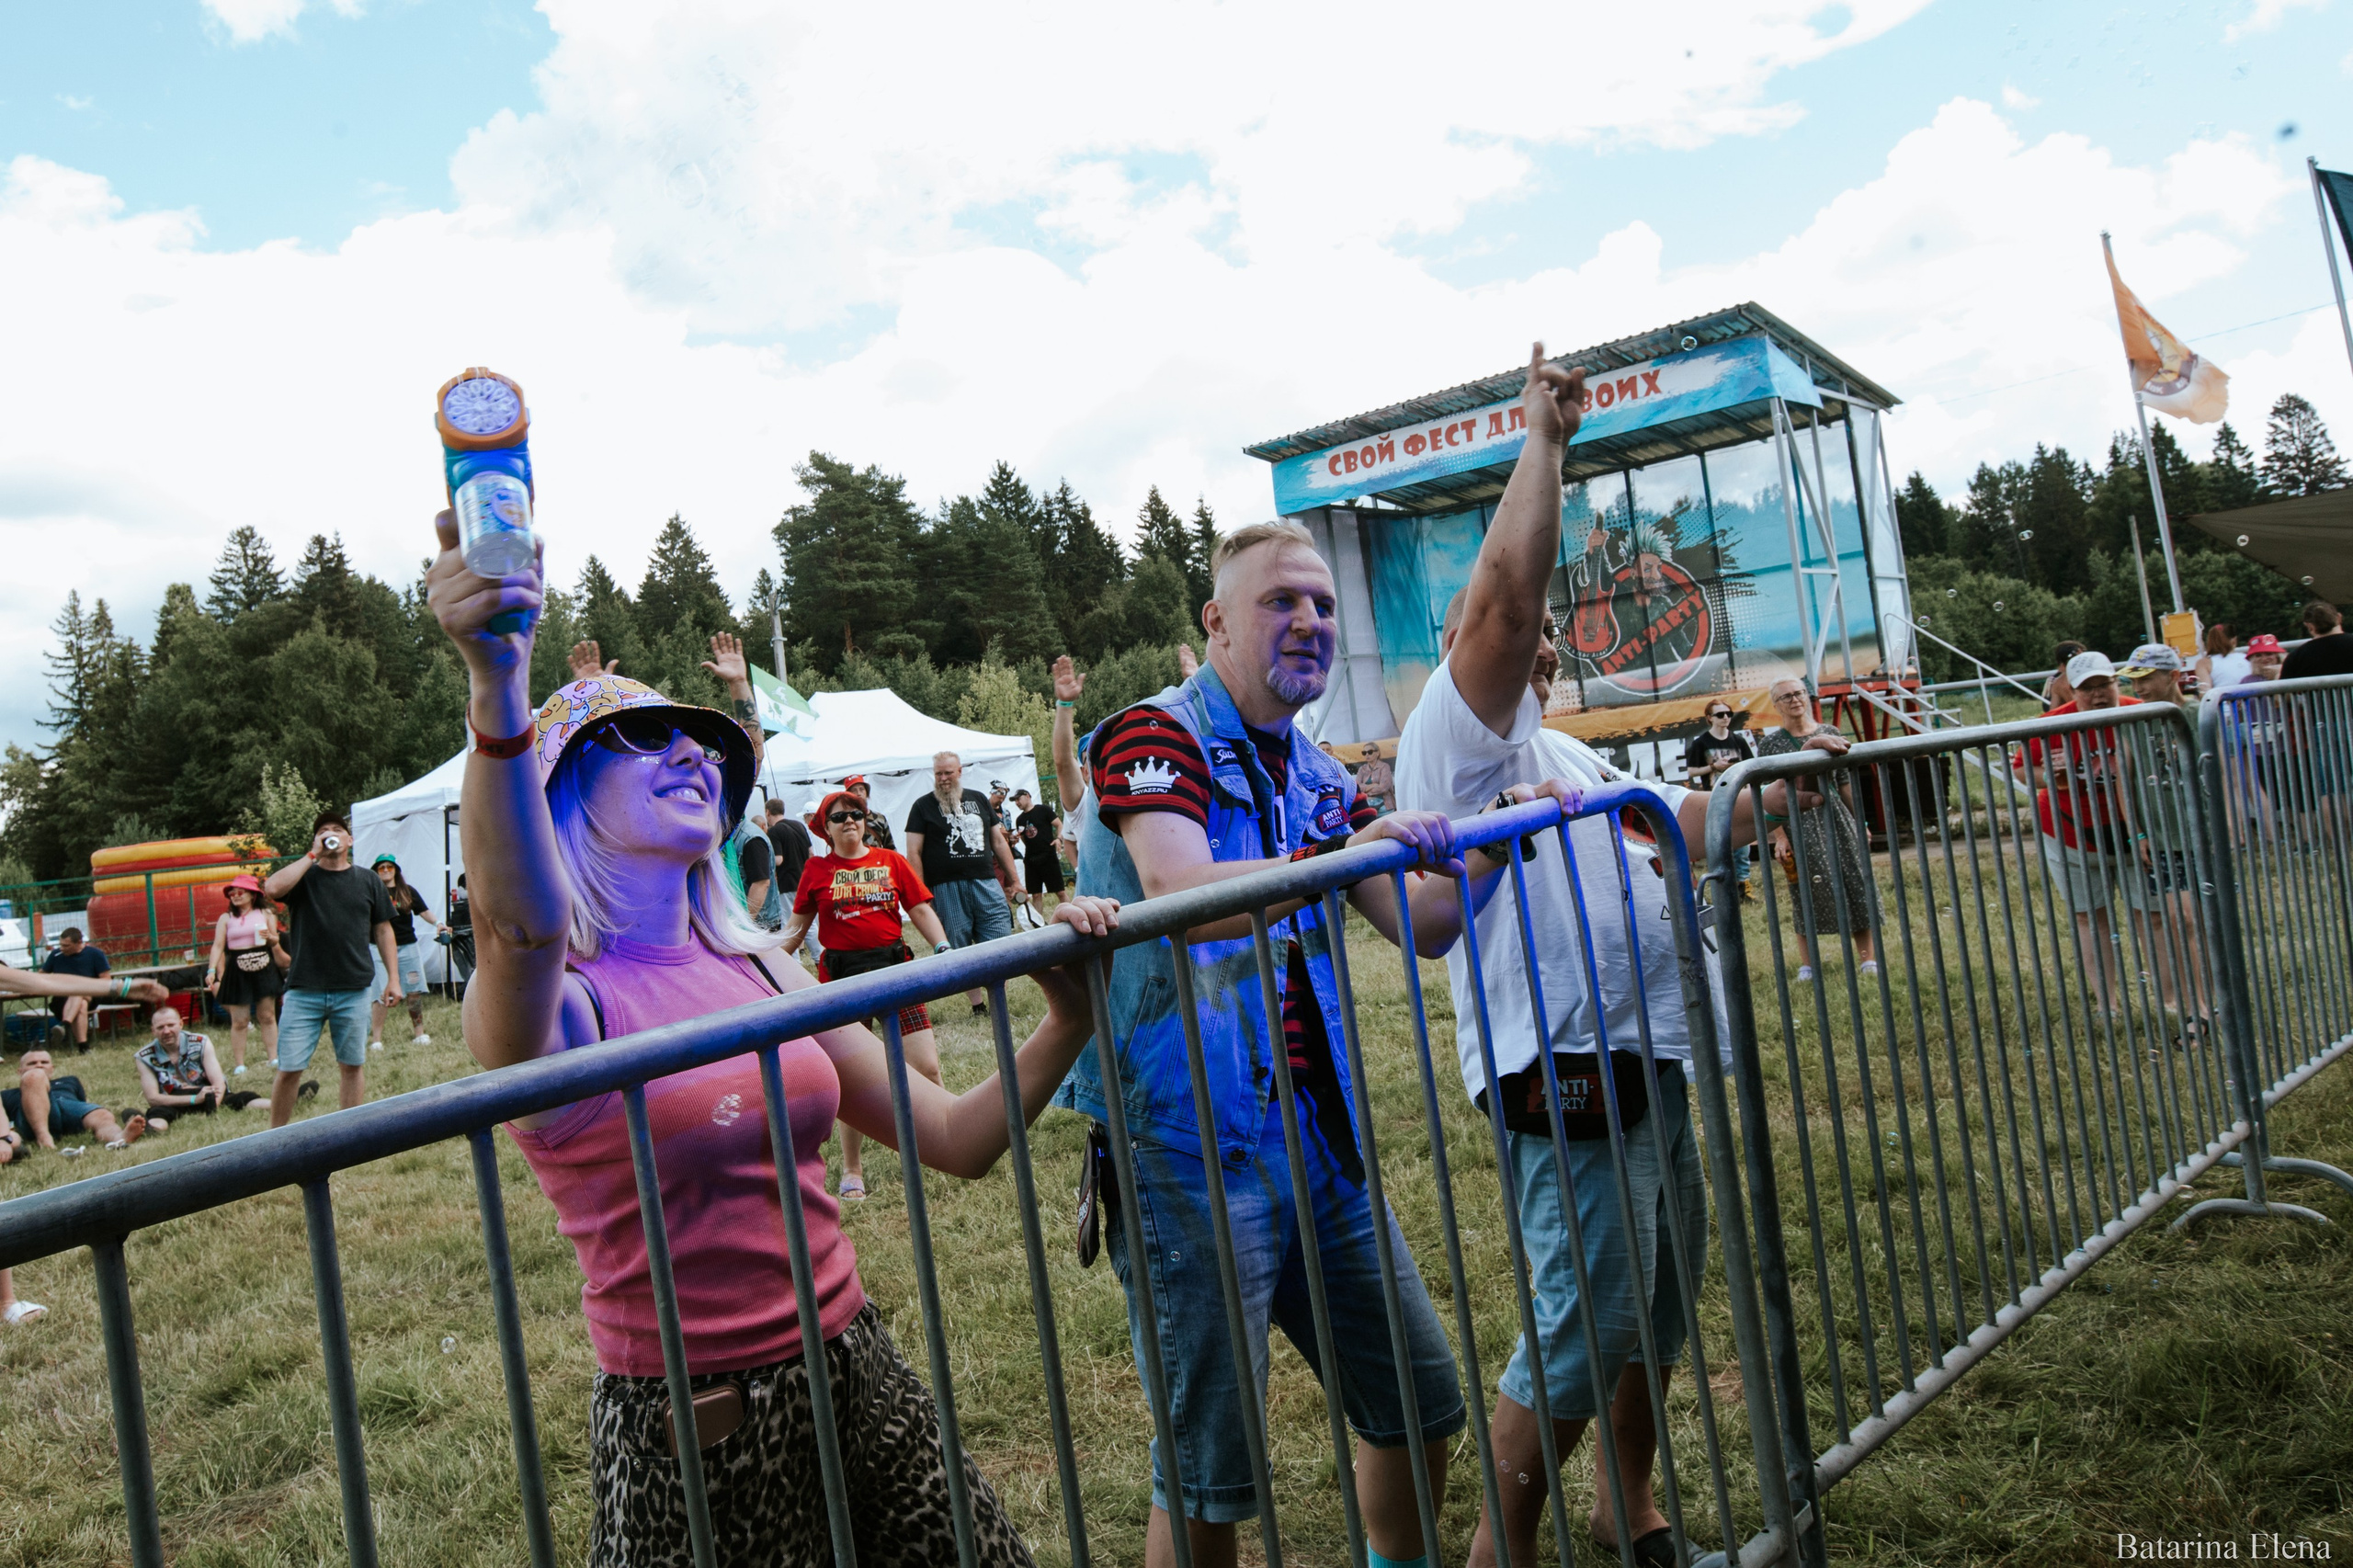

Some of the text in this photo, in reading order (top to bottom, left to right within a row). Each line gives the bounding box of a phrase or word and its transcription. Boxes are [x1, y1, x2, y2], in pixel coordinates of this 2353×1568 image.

[1328, 369, 1663, 476] СВОЙ ФЕСТ ДЛ ВОИХ
[1324, 815, 1343, 828] PARTY
[835, 869, 860, 884] СВОЙ
[832, 885, 852, 901] ДЛЯ
